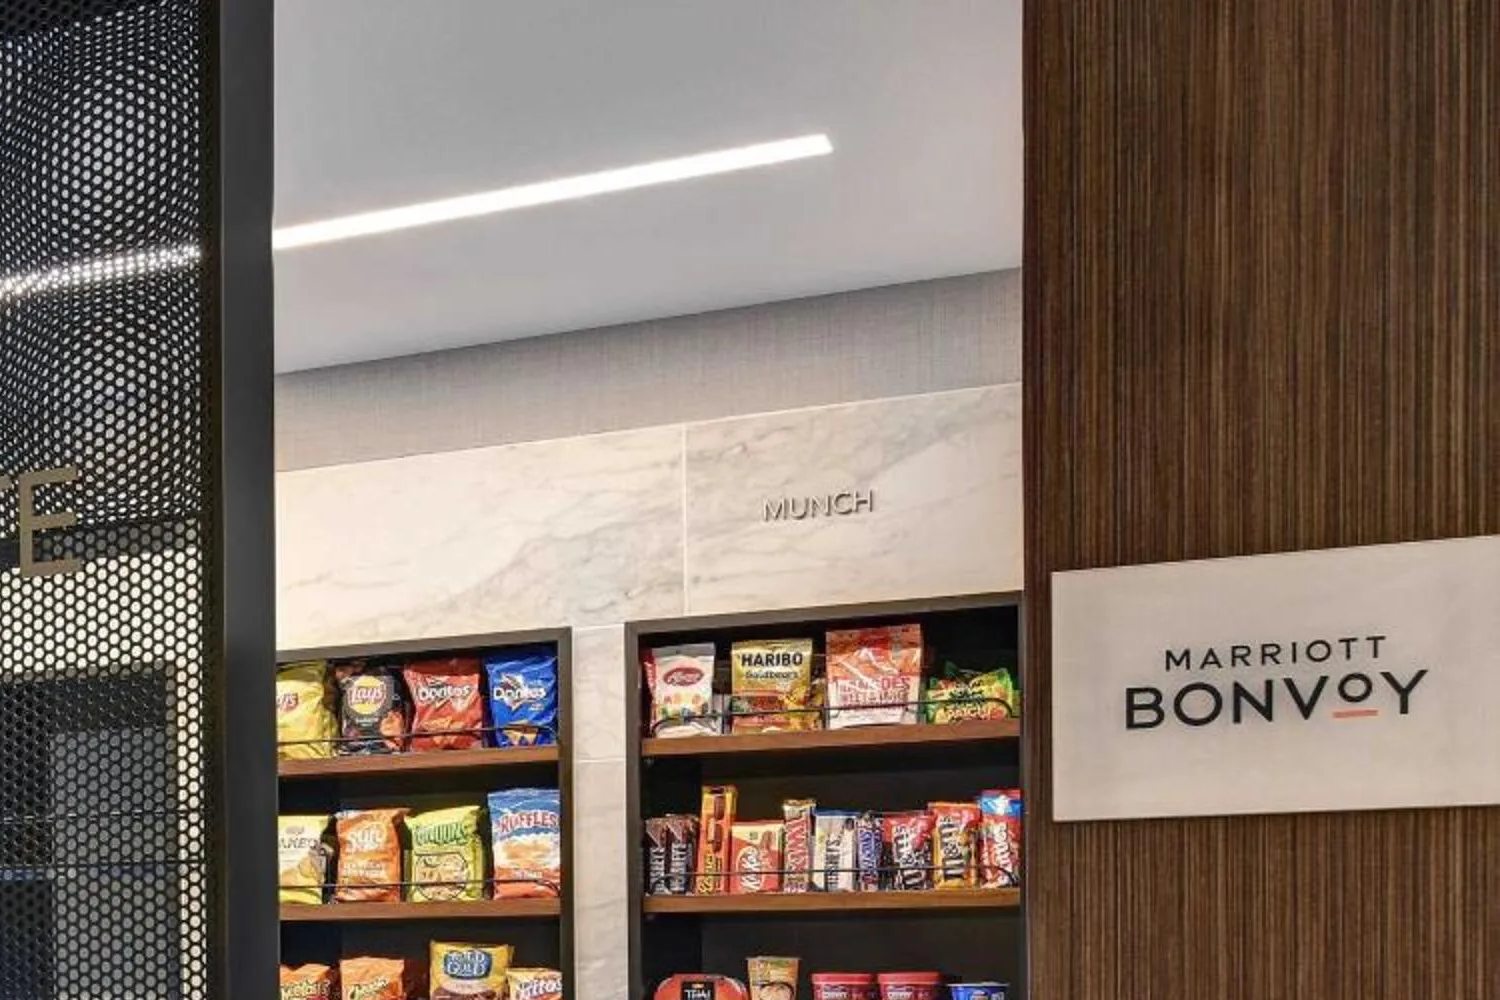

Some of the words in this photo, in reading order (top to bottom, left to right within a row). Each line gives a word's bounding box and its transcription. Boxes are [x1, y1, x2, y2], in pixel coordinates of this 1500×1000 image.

[763, 489, 873, 522] MUNCH
[740, 652, 804, 668] HARIBO
[1164, 635, 1387, 672] MARRIOTT
[1125, 669, 1429, 730] BONVOY
[501, 811, 559, 832] RUFFLES
